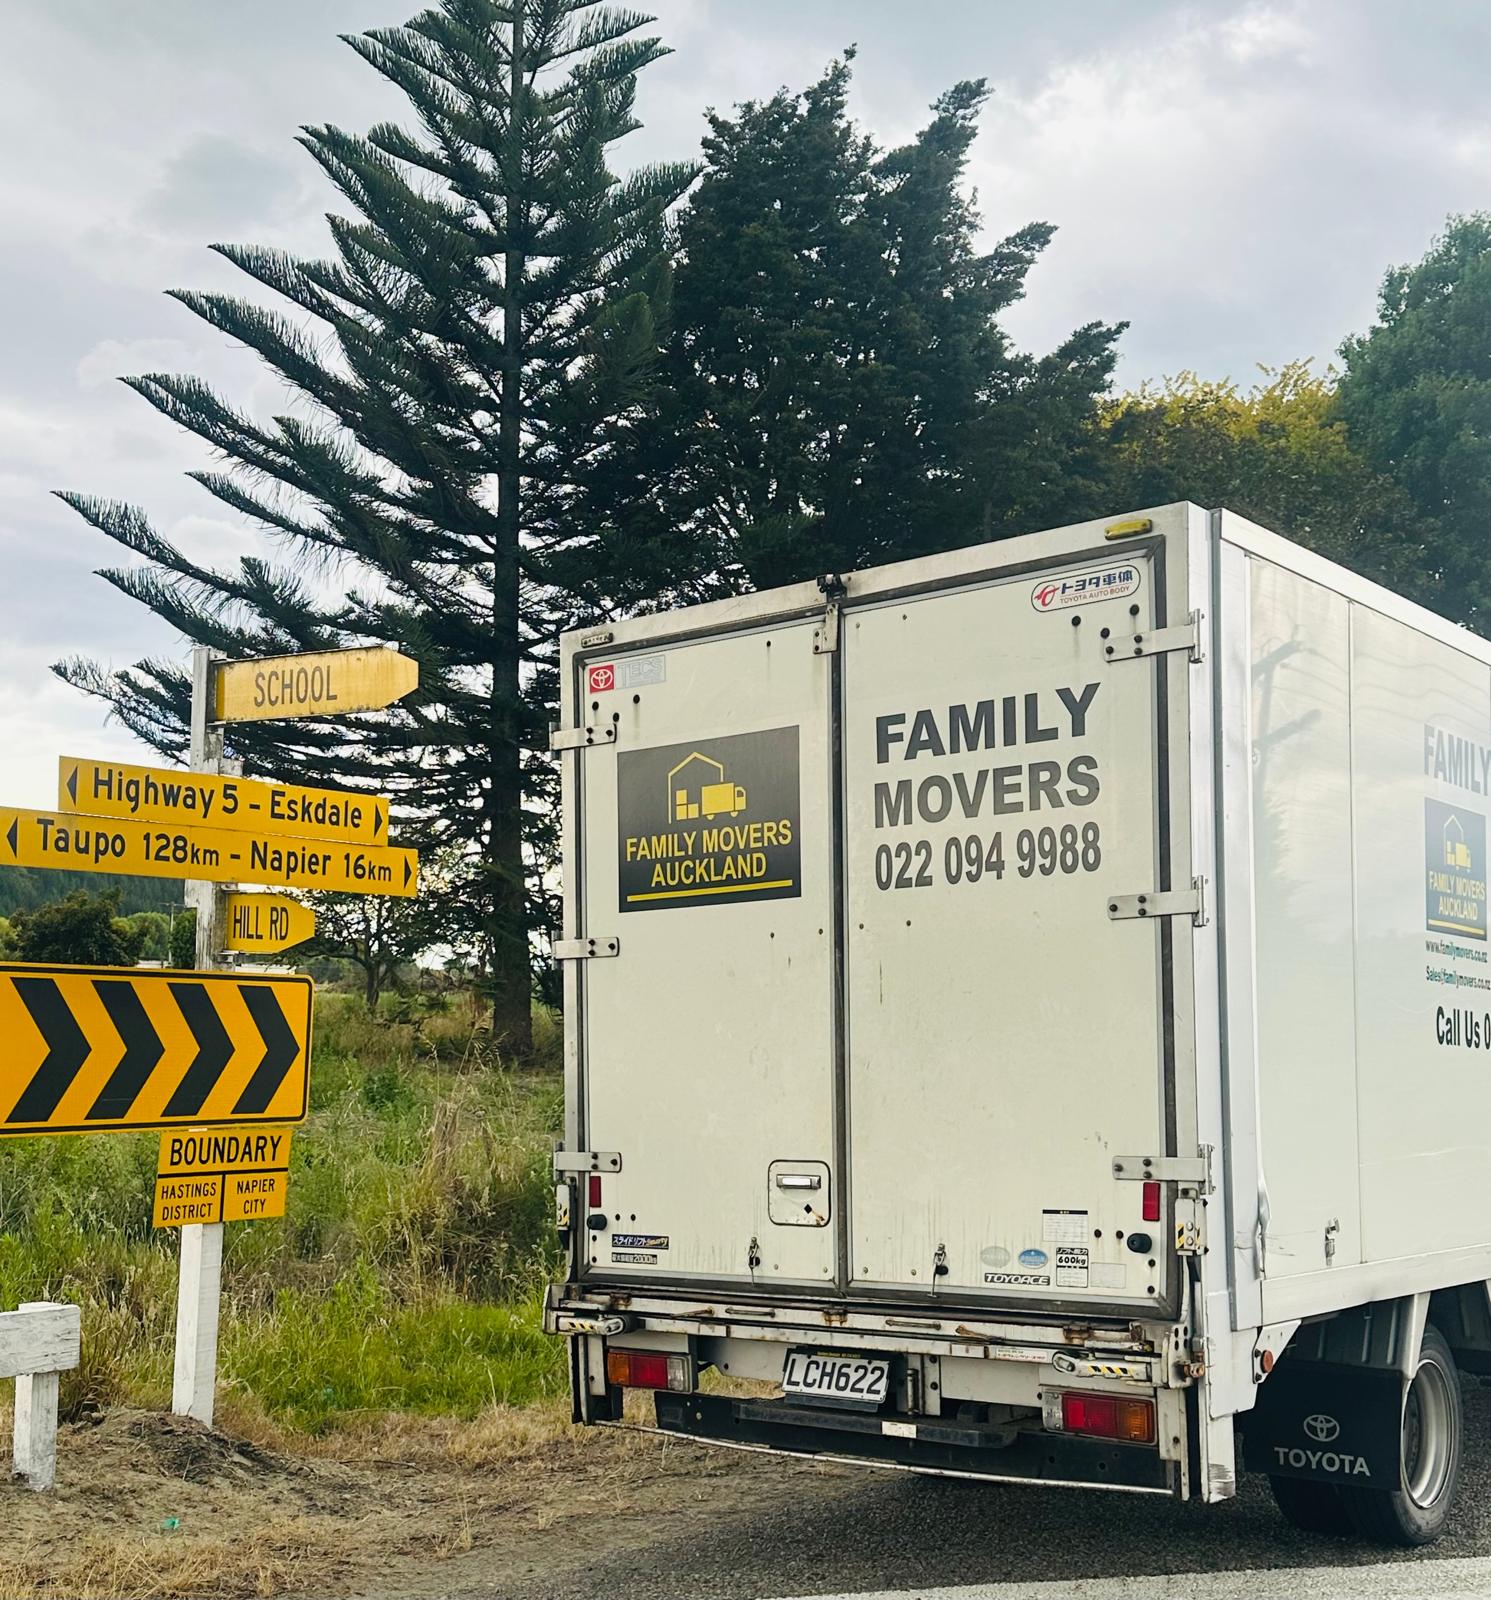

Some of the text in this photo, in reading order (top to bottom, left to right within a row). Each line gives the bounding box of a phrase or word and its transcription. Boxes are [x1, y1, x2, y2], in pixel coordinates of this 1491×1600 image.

[1060, 585, 1131, 604] TOYOTA AUTO BODY
[253, 665, 338, 707] SCHOOL
[875, 682, 1101, 764] FAMILY
[1424, 723, 1491, 796] FAMILY
[93, 767, 214, 818] Highway
[222, 783, 239, 814] 5
[270, 791, 362, 829] Eskdale
[874, 755, 1100, 829] MOVERS
[36, 818, 126, 863] Taupo
[143, 832, 220, 867] 128km
[251, 841, 331, 880] Napier
[344, 853, 392, 882] 16km
[626, 819, 792, 862] FAMILY MOVERS
[875, 821, 1101, 891] 022 094 9988
[651, 852, 766, 887] AUCKLAND
[1429, 870, 1485, 901] FAMILY MOVERS
[233, 904, 289, 941] HILL RD
[1439, 895, 1478, 920] AUCKLAND
[1436, 1006, 1461, 1046] Call
[1465, 1010, 1481, 1049] Us
[170, 1135, 282, 1166] BOUNDARY
[161, 1182, 217, 1199] HASTINGS
[237, 1178, 275, 1194] NAPIER
[162, 1203, 213, 1221] DISTRICT
[243, 1199, 267, 1215] CITY
[1058, 1256, 1086, 1265] 600kg
[985, 1273, 1049, 1285] TOYOACE
[786, 1358, 885, 1394] LCH622
[1273, 1446, 1371, 1477] TOYOTA
